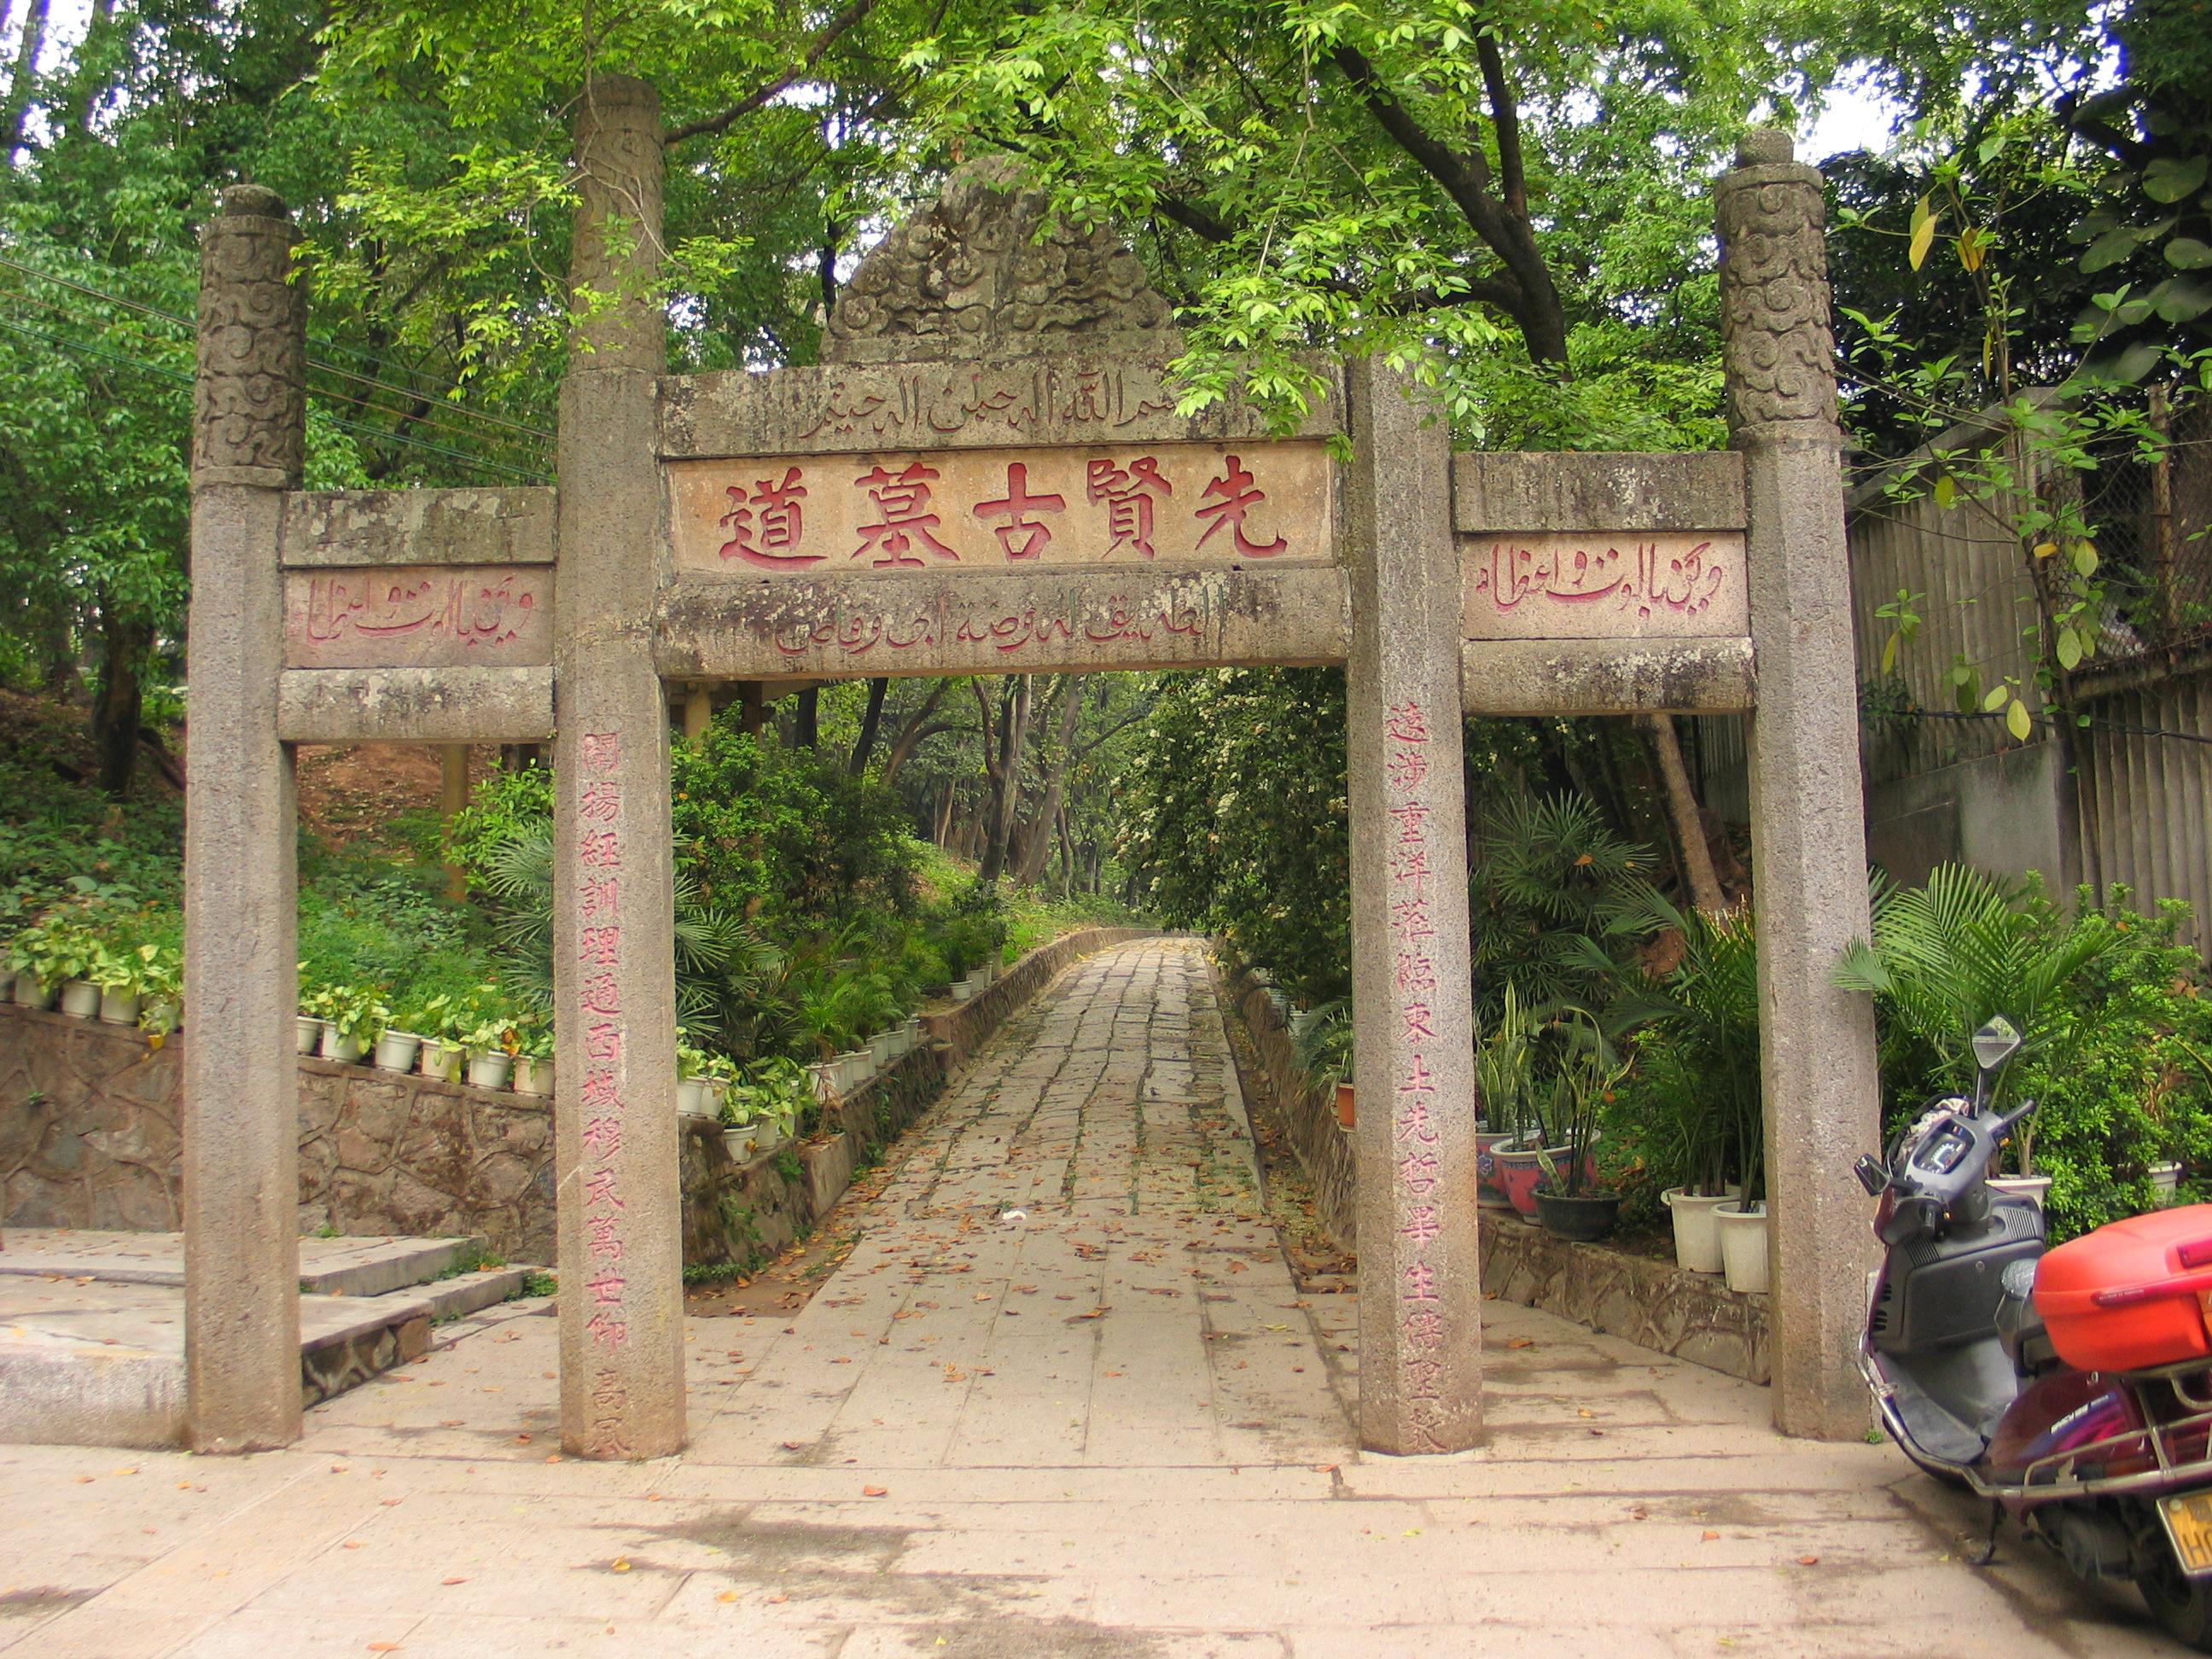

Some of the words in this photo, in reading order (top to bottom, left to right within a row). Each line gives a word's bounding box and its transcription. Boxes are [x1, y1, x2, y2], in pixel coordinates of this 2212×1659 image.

[719, 455, 1289, 572] 先賢古墓道
